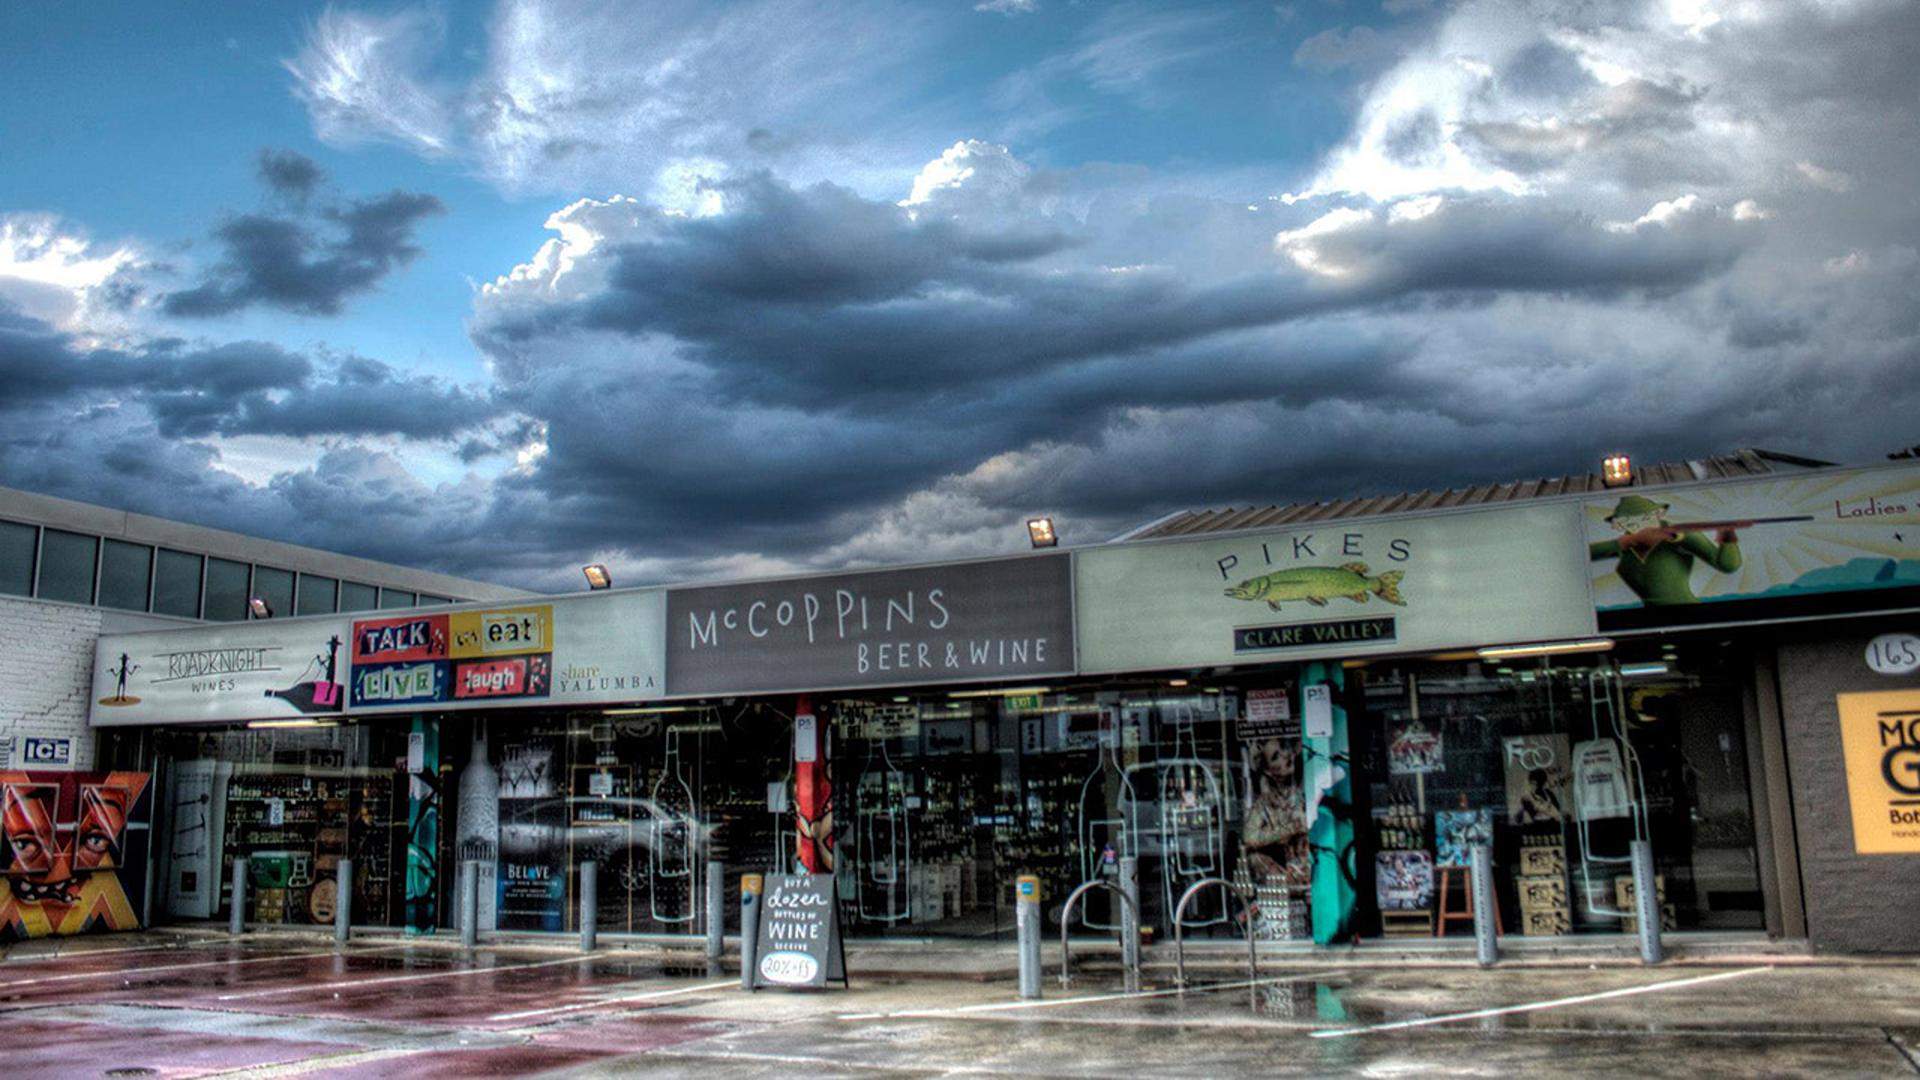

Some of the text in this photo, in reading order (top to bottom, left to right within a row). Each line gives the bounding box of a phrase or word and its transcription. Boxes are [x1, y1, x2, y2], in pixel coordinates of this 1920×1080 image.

[1836, 496, 1907, 519] Ladies
[1216, 532, 1412, 581] PIKES
[368, 622, 426, 654] TALK
[488, 617, 532, 643] eat
[1243, 621, 1386, 648] CLARE VALLEY
[168, 648, 267, 679] ROADKNIGHT
[857, 637, 1048, 674] BEER & WINE
[1873, 640, 1917, 668] 165
[191, 680, 235, 693] WINES
[464, 667, 517, 691] laugh
[560, 675, 655, 693] YALUMBA
[27, 741, 69, 760] ICE
[768, 886, 827, 907] dozen
